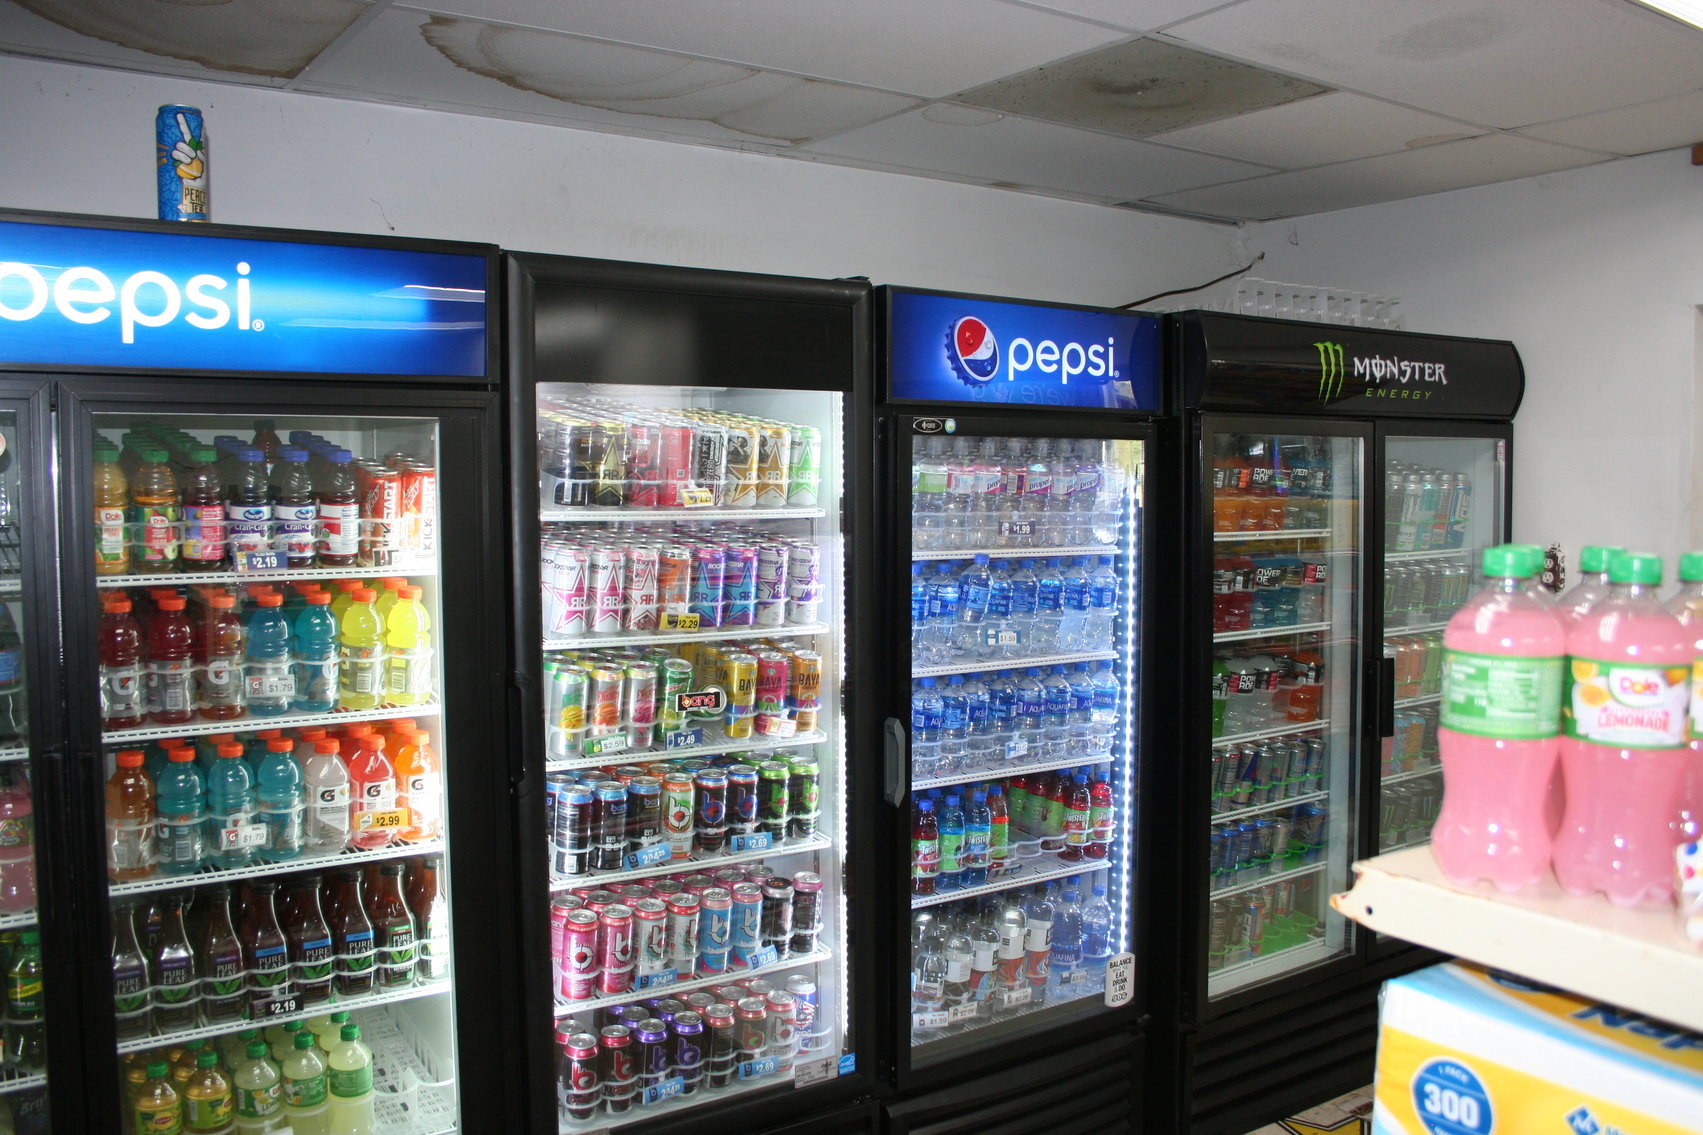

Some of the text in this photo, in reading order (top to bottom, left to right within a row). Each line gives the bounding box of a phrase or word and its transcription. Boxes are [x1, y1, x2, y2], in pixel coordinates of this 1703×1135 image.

[1008, 337, 1115, 384] pepsi
[1353, 355, 1448, 386] MONSTER
[1365, 388, 1432, 399] ENERGY
[252, 556, 278, 569] $2.19
[678, 619, 698, 629] $2.29
[798, 673, 820, 686] BAYA
[1619, 677, 1660, 694] Dole
[268, 683, 293, 692] $1.79
[1597, 711, 1669, 733] LEMONADE
[603, 741, 624, 750] $2.59
[320, 789, 336, 803] G
[366, 783, 381, 798] G
[376, 815, 400, 827] $2.99
[749, 837, 768, 849] $2.69
[392, 932, 412, 941] PURE
[349, 938, 373, 948] PURE
[306, 947, 330, 956] PURE
[258, 954, 284, 964] PURE
[1109, 957, 1132, 969] BALANCE
[217, 962, 238, 971] PURE
[163, 969, 187, 978] PURE
[1112, 977, 1128, 986] DRINK
[271, 1001, 296, 1014] $2.19
[756, 1062, 775, 1073] $2.69
[1445, 1066, 1471, 1084] PACK
[1423, 1082, 1479, 1129] 300
